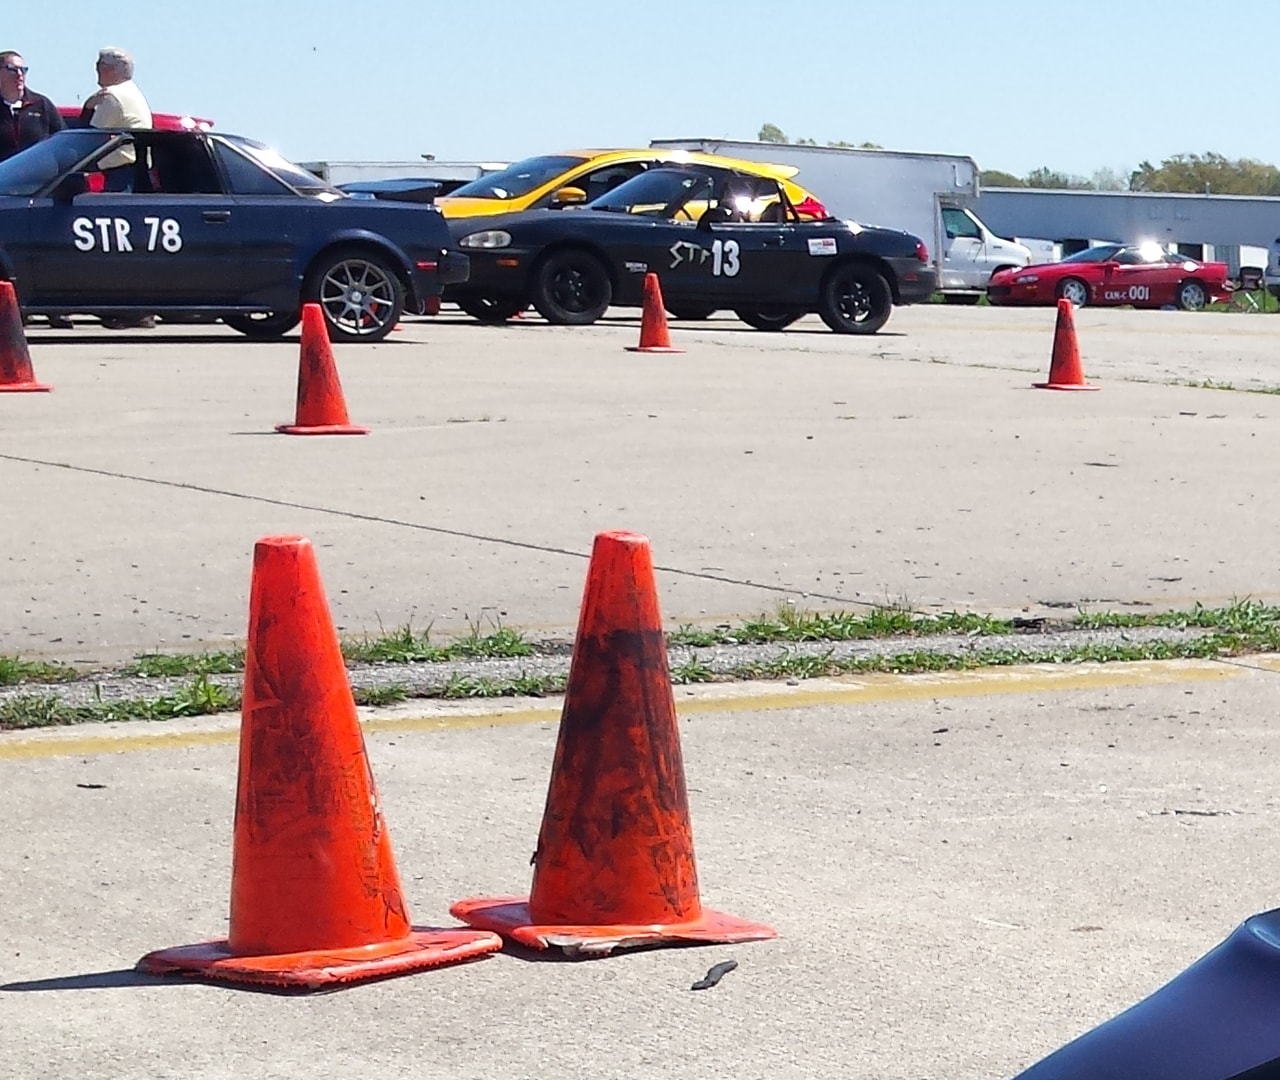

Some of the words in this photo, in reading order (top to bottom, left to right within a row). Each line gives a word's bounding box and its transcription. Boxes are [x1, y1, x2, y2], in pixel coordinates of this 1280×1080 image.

[73, 217, 133, 252] STR
[144, 217, 182, 253] 78
[711, 239, 740, 277] 13
[1129, 285, 1150, 301] 001
